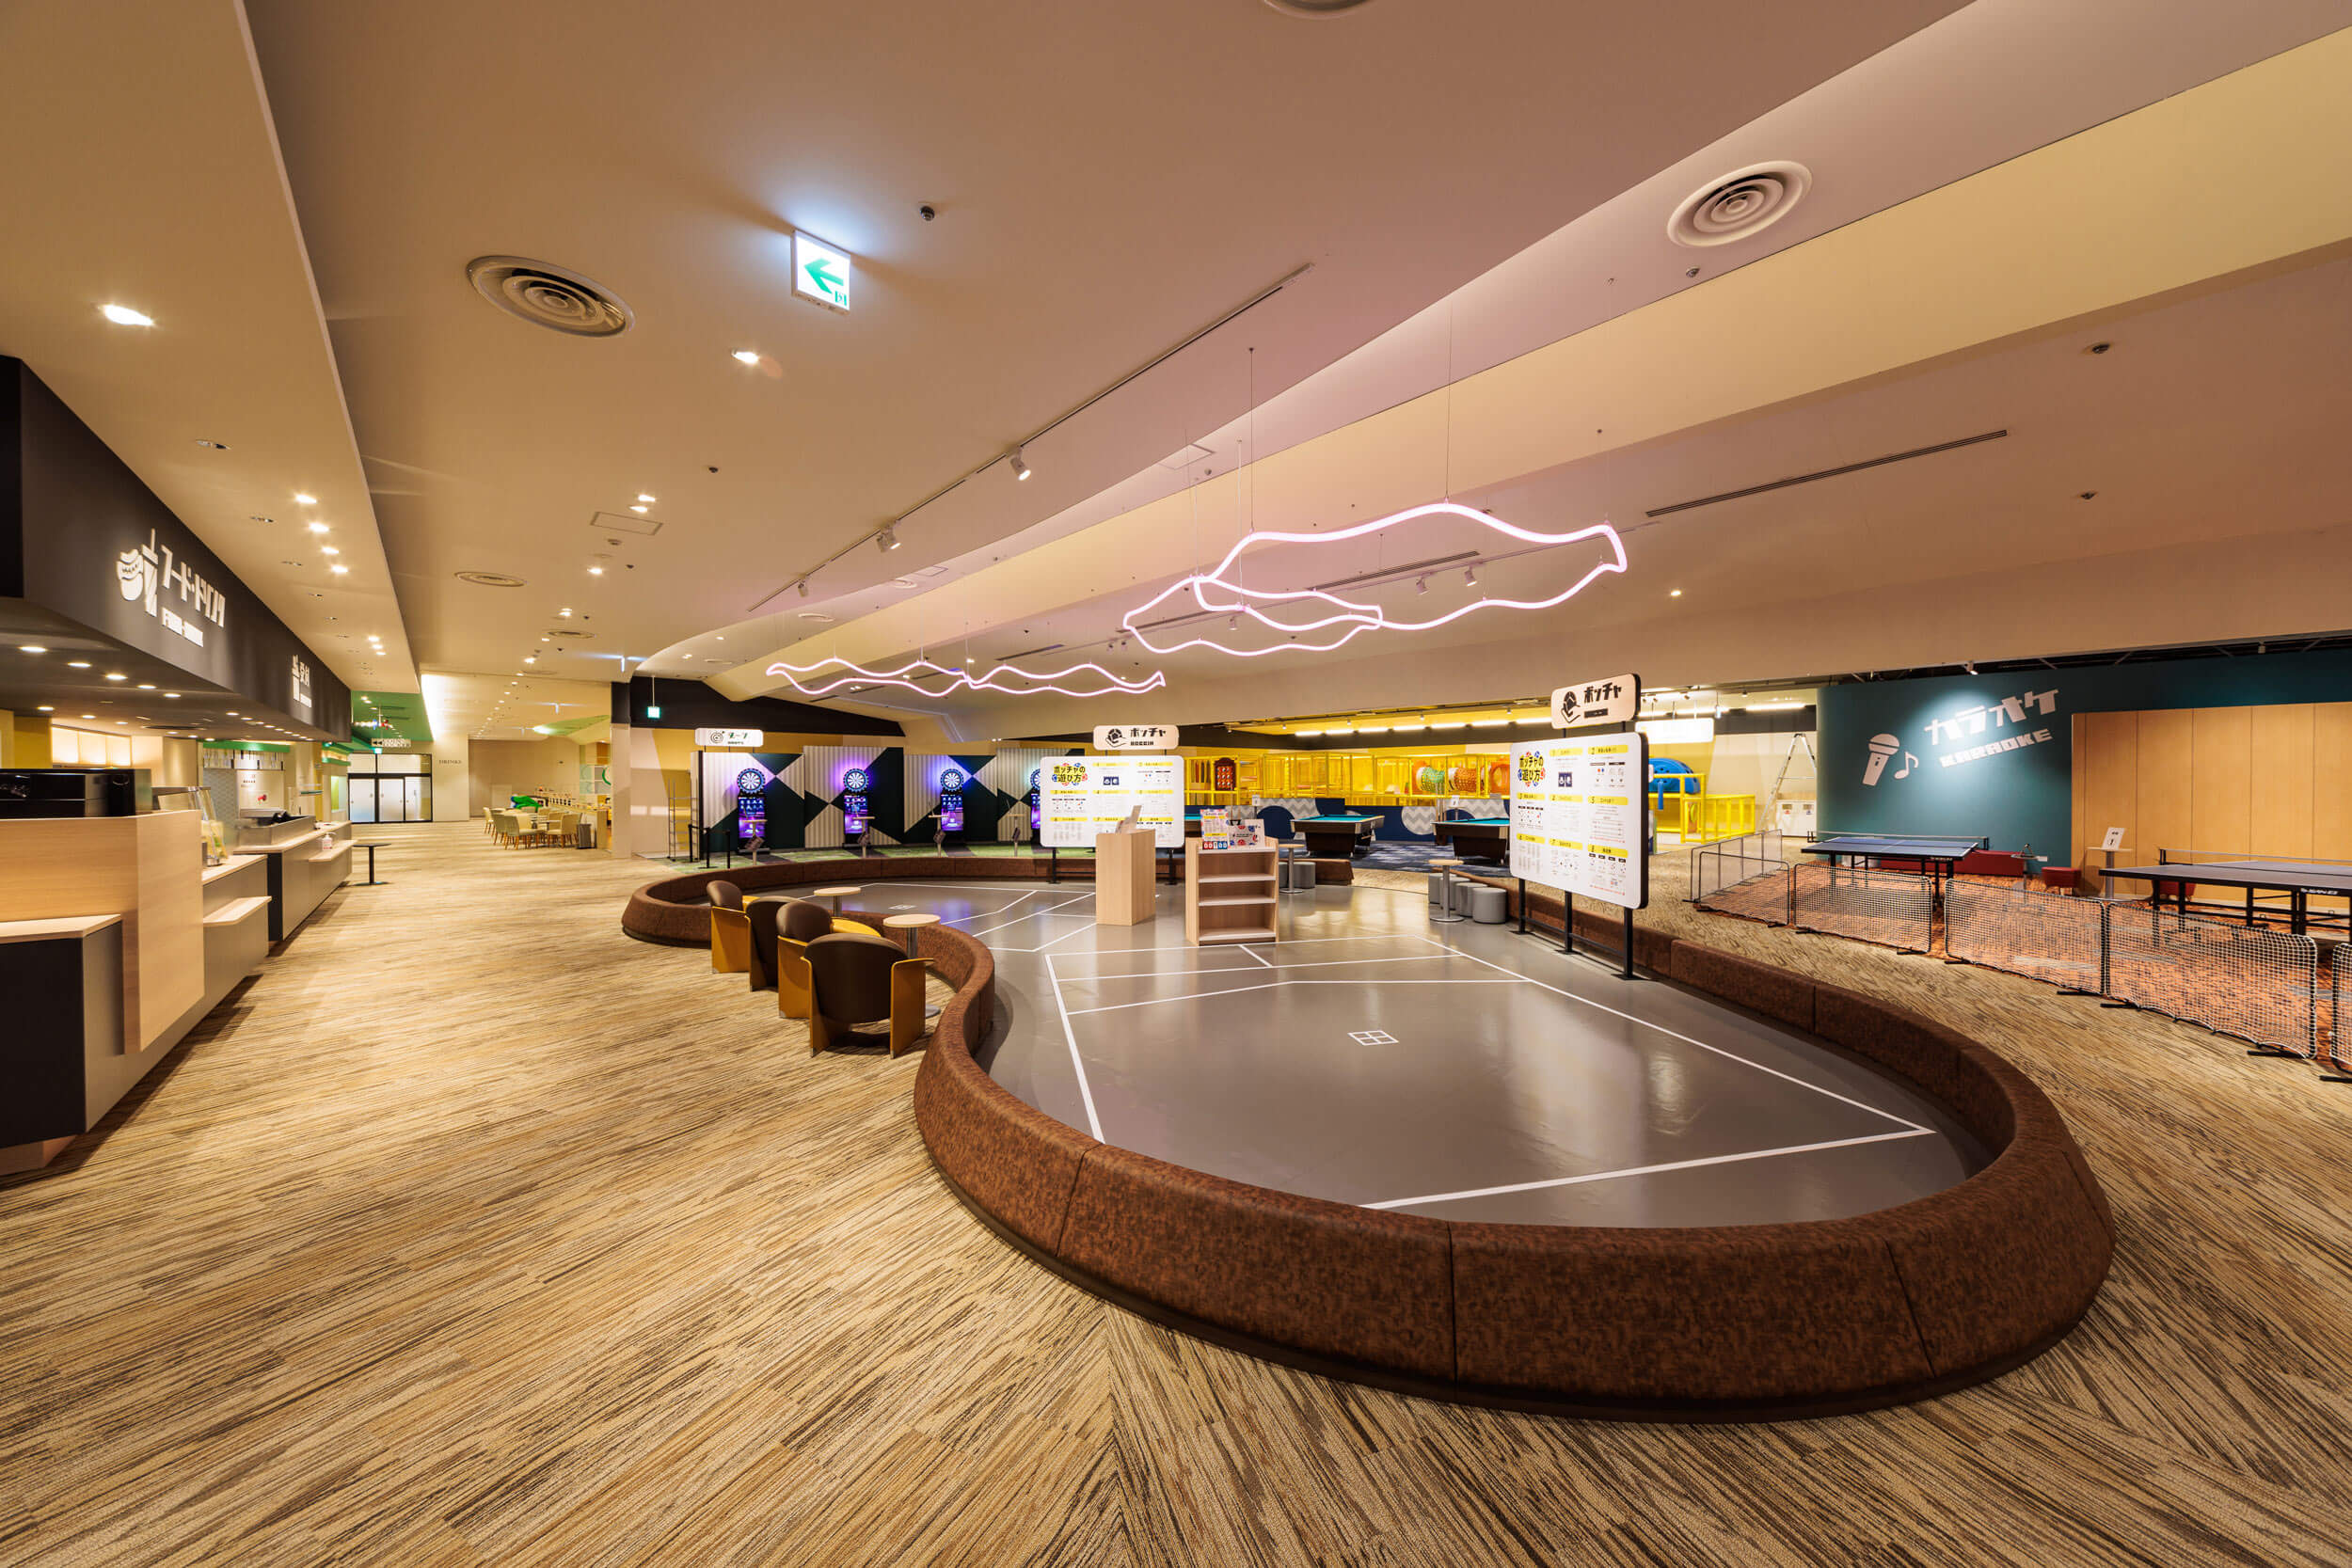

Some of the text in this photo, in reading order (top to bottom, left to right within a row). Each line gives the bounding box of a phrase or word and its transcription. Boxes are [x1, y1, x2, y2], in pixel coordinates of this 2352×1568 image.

[1583, 682, 1621, 704] ボッチャ
[1130, 727, 1166, 737] ボッチャ
[1924, 688, 2058, 746] カラオケ
[1939, 728, 2053, 768] KARAOKE
